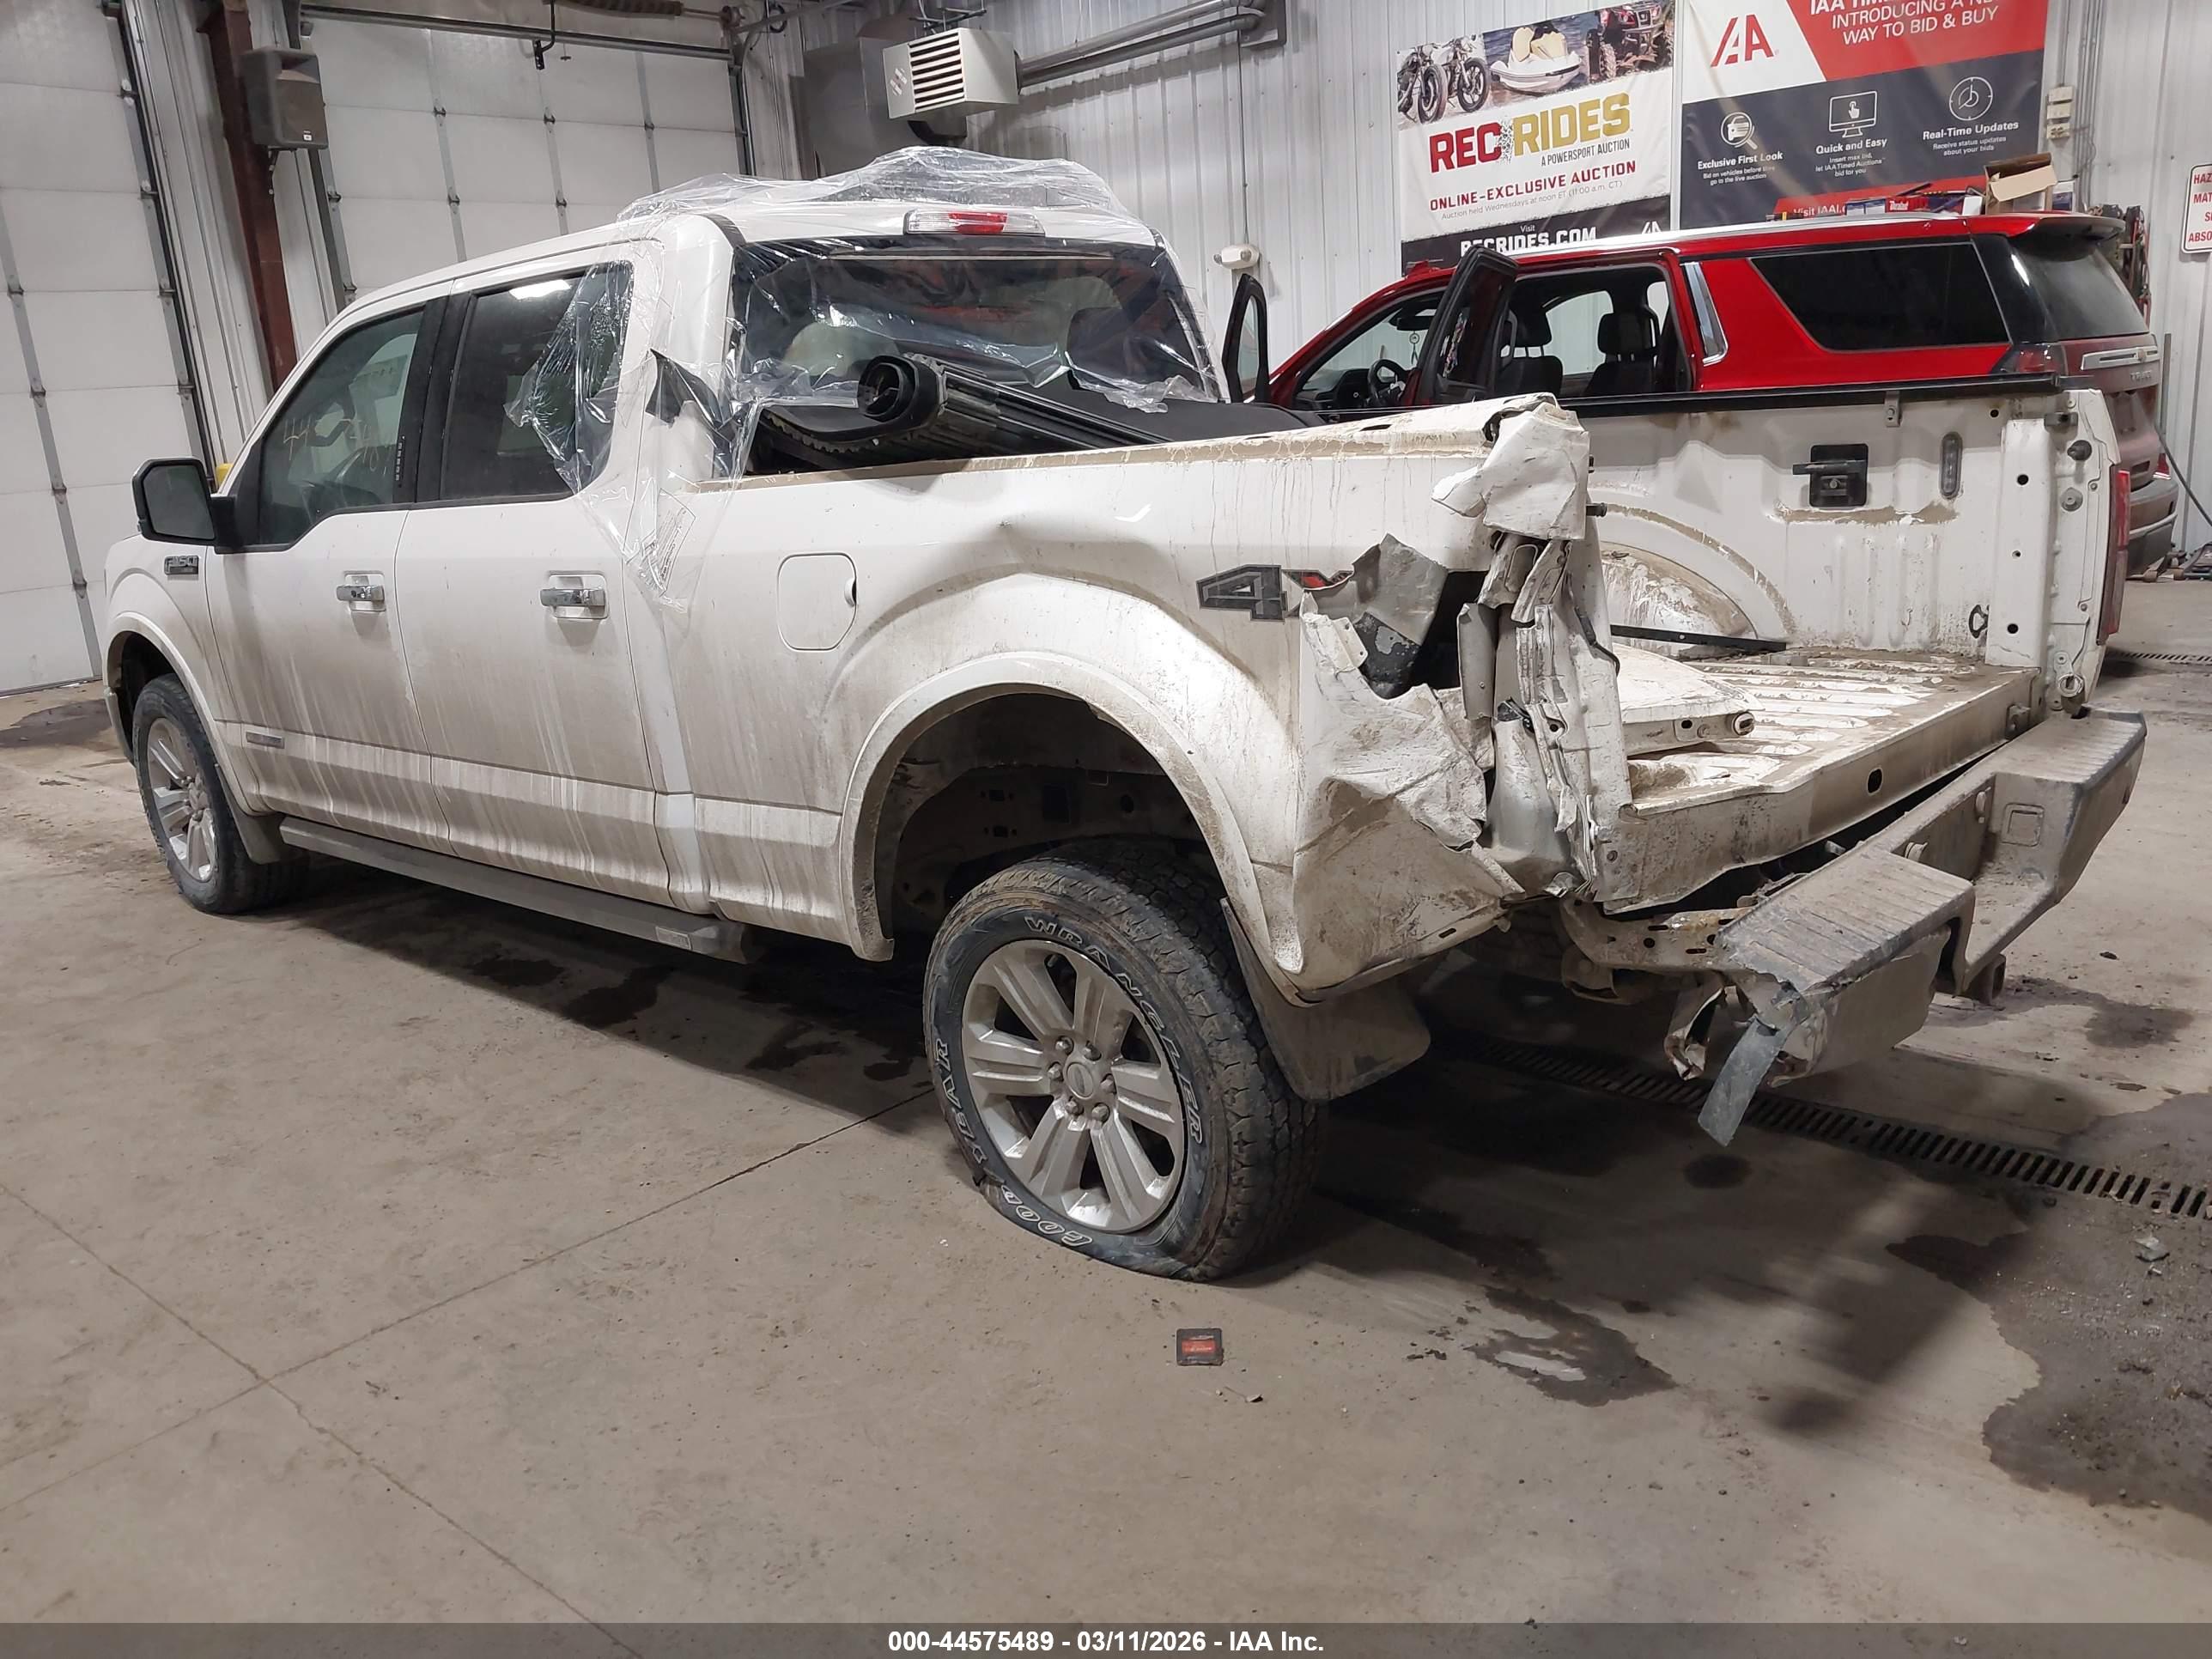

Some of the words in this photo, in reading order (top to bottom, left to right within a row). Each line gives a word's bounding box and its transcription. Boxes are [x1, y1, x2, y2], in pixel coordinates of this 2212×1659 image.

[1832, 0, 1946, 29] INTRODUCING
[1843, 25, 1878, 46] WAY
[1882, 21, 1905, 39] TO
[1910, 16, 1938, 33] BID
[1942, 13, 1956, 29] &
[1961, 5, 1999, 26] BUY
[1429, 122, 1503, 173] REC
[1512, 92, 1631, 157] RIDES
[1923, 127, 1972, 140] Real-Time
[1975, 122, 2019, 135] Updates
[1979, 137, 2007, 145] updates
[1540, 155, 1546, 167] A
[1547, 146, 1595, 166] POWERSPORT
[1597, 139, 1630, 155] AUCTION
[1697, 158, 1736, 170] Exclusive
[1738, 155, 1758, 164] First
[1760, 150, 1784, 161] Look
[1815, 143, 1844, 155] Quick
[1845, 140, 1863, 151] and
[1865, 138, 1887, 149] Easy
[1430, 174, 1566, 211] ONLINE-EXCLUSIVE
[1571, 161, 1636, 185] AUCTION
[1442, 210, 1468, 221] Auction
[1468, 206, 1483, 215] held
[1486, 199, 1528, 212] Wednesdays
[1559, 190, 1566, 198] ET
[1793, 208, 1815, 216] Visit
[1520, 224, 1535, 233] Visit
[1024, 915, 1203, 1145] WRANGLER
